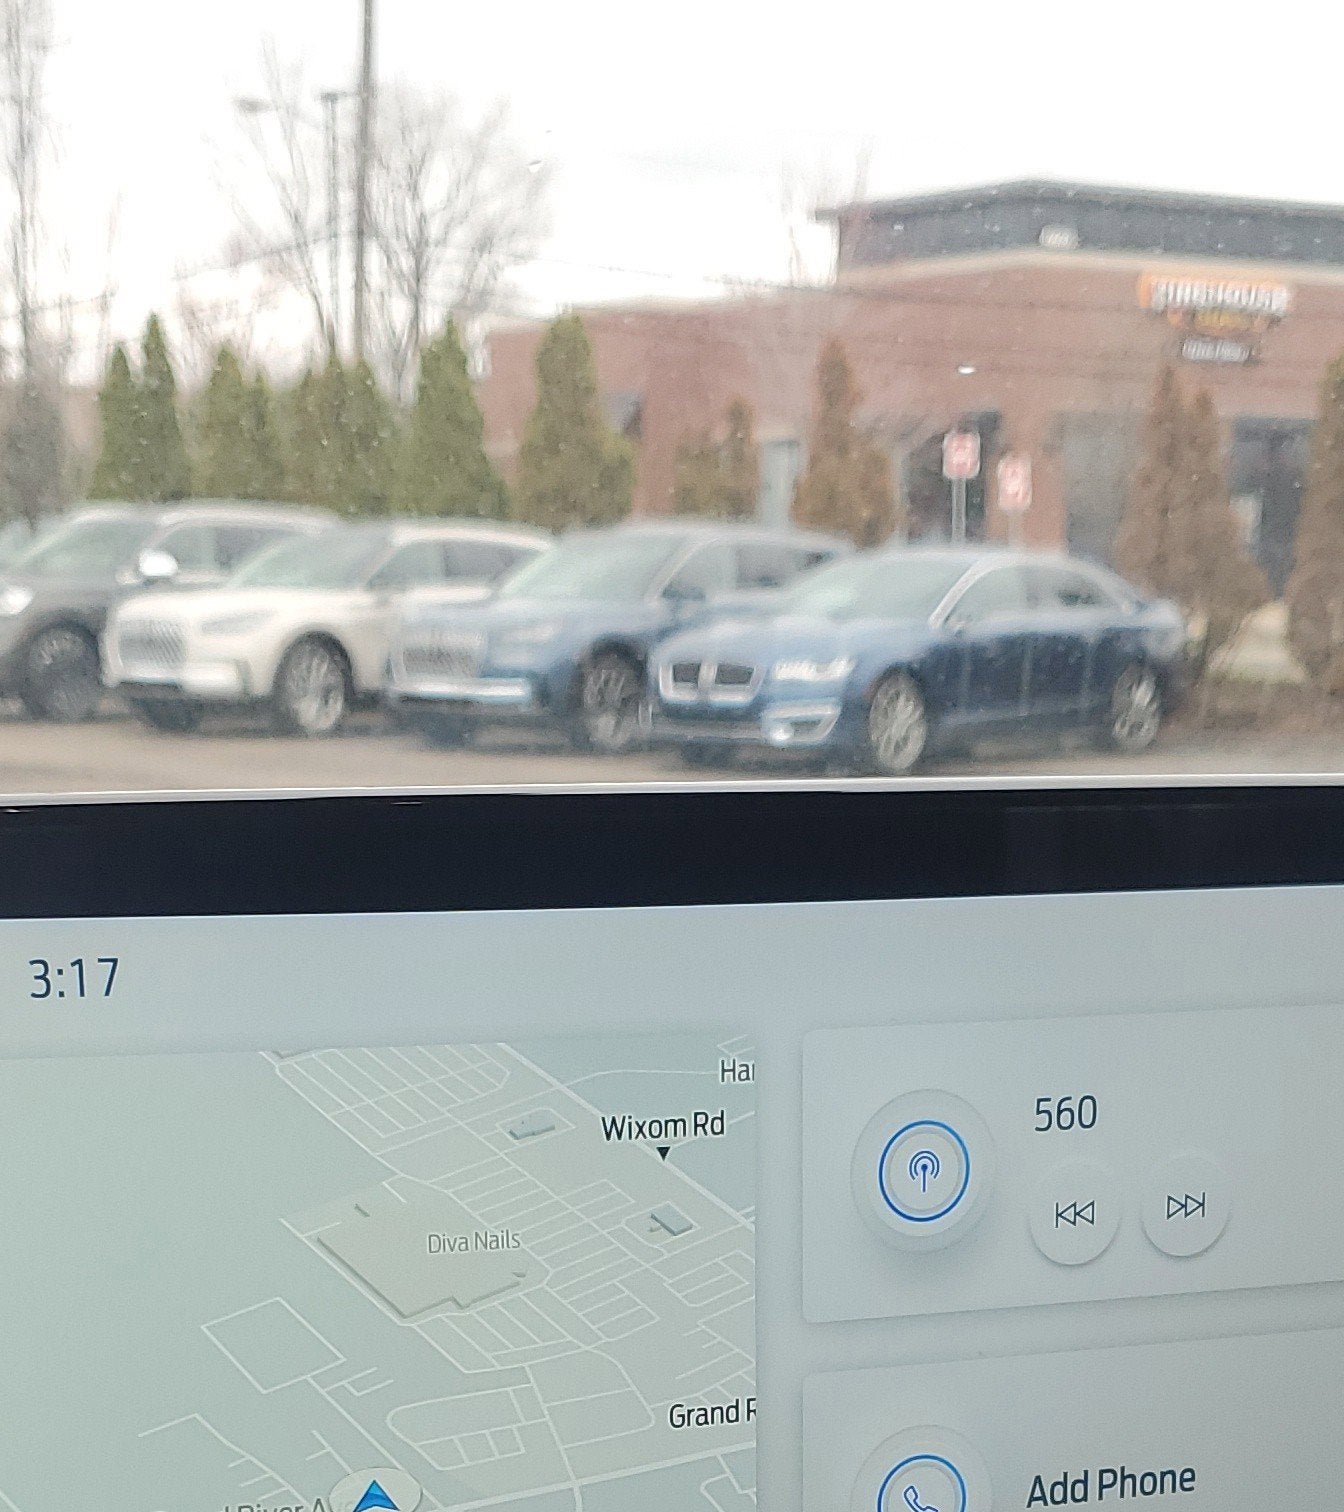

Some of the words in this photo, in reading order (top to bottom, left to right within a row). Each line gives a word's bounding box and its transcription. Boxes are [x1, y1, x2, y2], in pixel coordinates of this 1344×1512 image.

[29, 957, 119, 999] 3:17
[601, 1115, 687, 1141] Wixom
[693, 1109, 725, 1137] Rd
[1034, 1094, 1098, 1132] 560
[428, 1233, 469, 1254] Diva
[474, 1229, 521, 1251] Nails
[669, 1398, 740, 1429] Grand
[1026, 1469, 1089, 1509] Add
[1098, 1465, 1196, 1501] Phone
